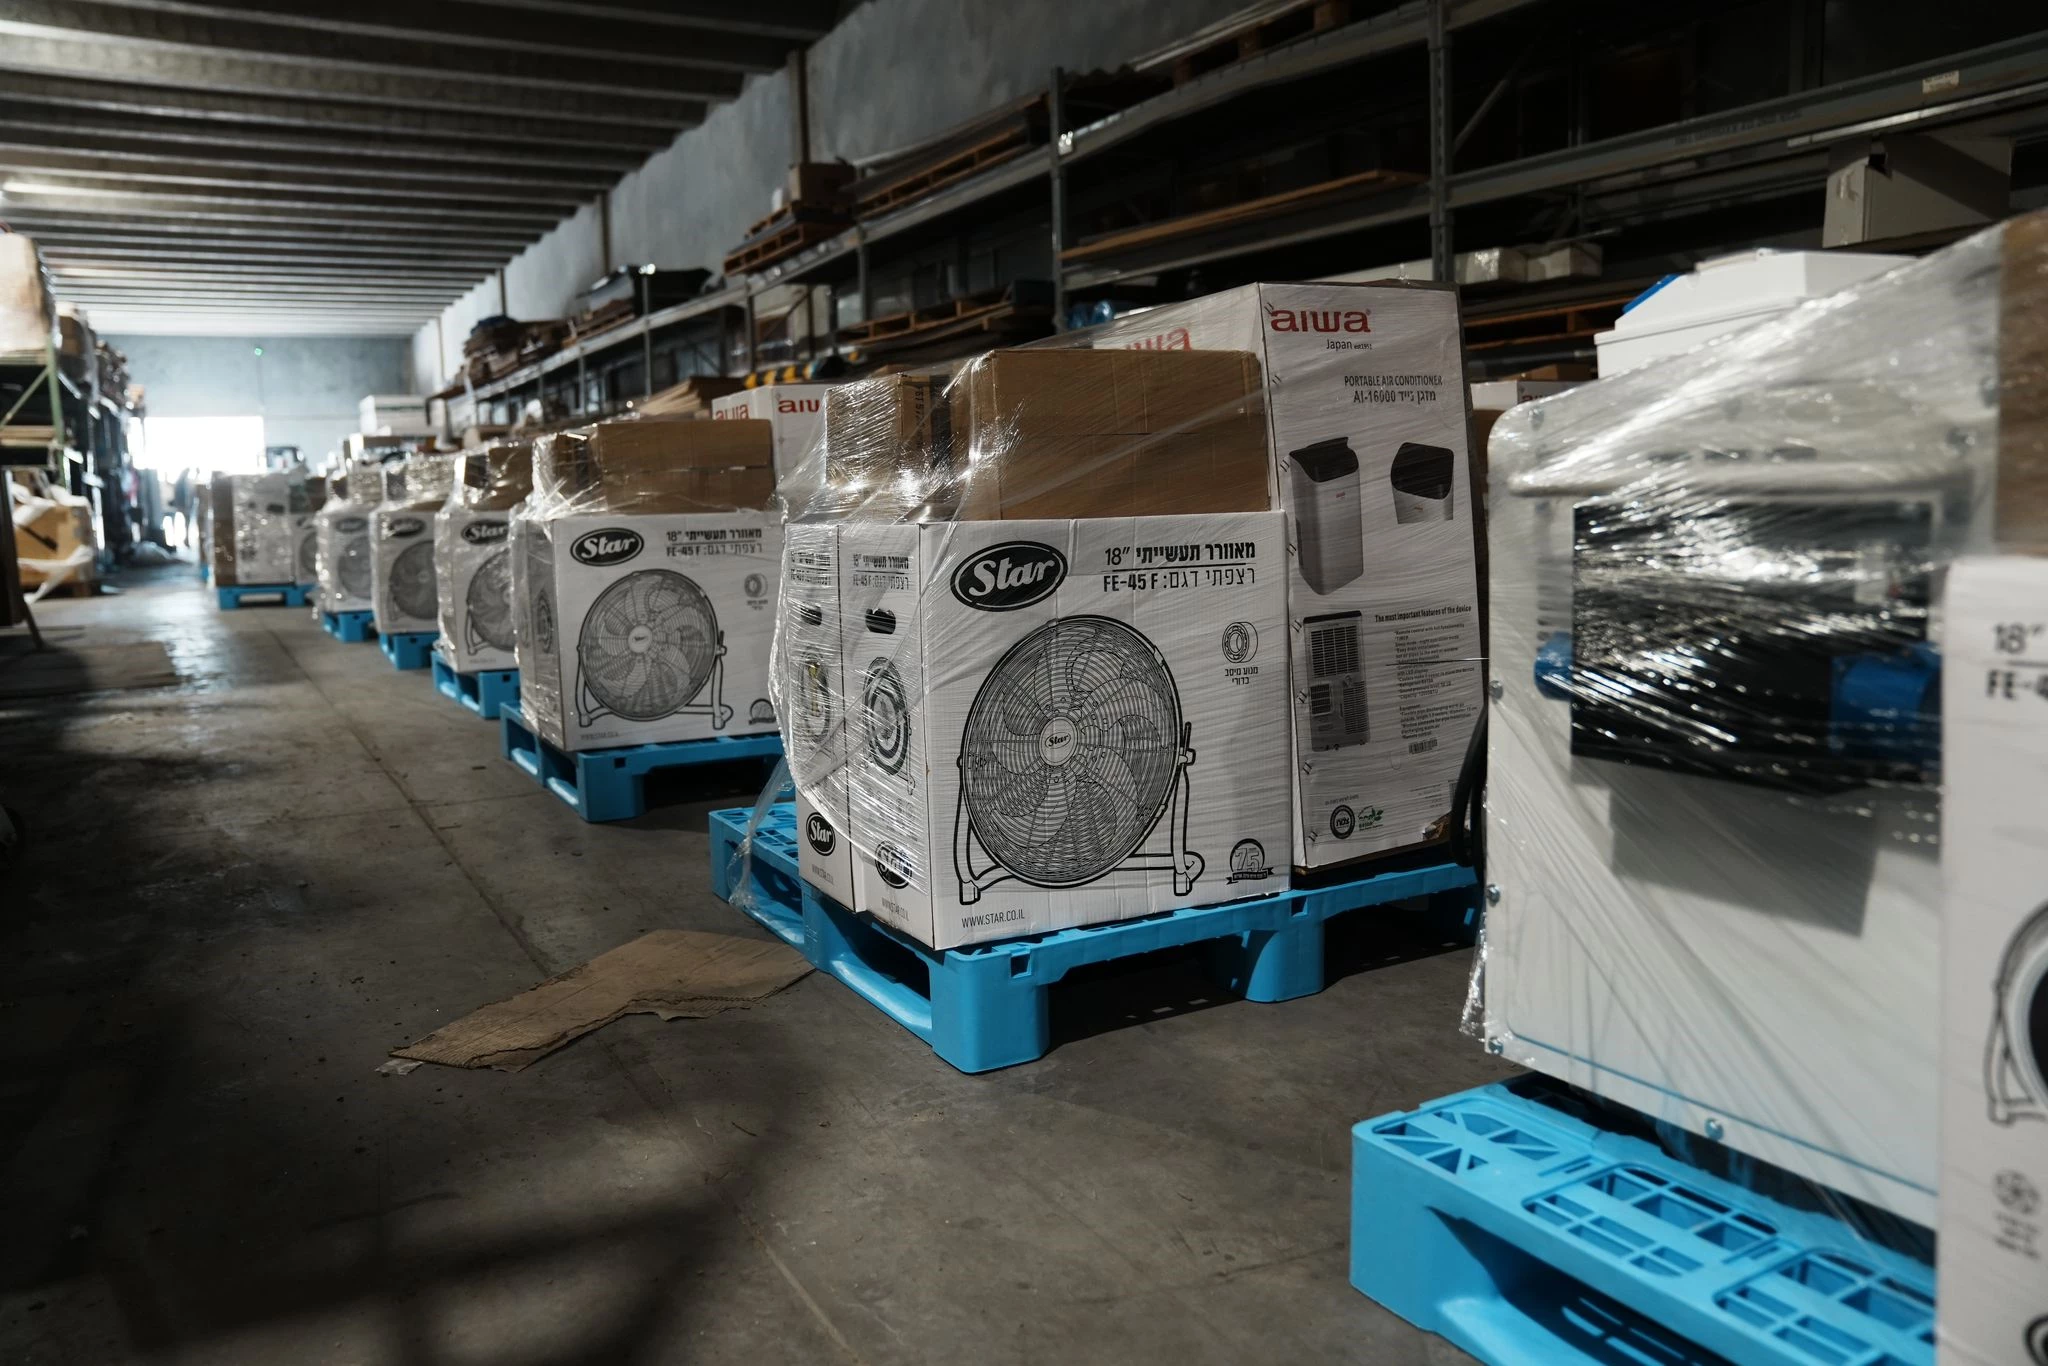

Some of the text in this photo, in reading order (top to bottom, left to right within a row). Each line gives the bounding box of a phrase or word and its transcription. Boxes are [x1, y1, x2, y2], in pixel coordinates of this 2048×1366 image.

[1270, 308, 1371, 333] aiwa
[1326, 339, 1353, 352] Japan
[1344, 375, 1443, 387] PORTABLE AIR CONDITIONER
[1353, 390, 1396, 404] AI-16000
[580, 536, 636, 560] Star
[1135, 544, 1201, 565] תעשייתי
[1205, 541, 1256, 561] מאוורר
[968, 556, 1056, 597] Star
[1103, 573, 1147, 592] FE-45
[1205, 567, 1256, 586] רצפתי
[1375, 605, 1472, 622] The most important features of the device
[1242, 666, 1259, 676] מנוע
[1048, 734, 1069, 747] Star
[808, 820, 833, 844] Star
[1234, 847, 1260, 872] 75
[961, 911, 1025, 929] WWW.STAR.CO.IL
